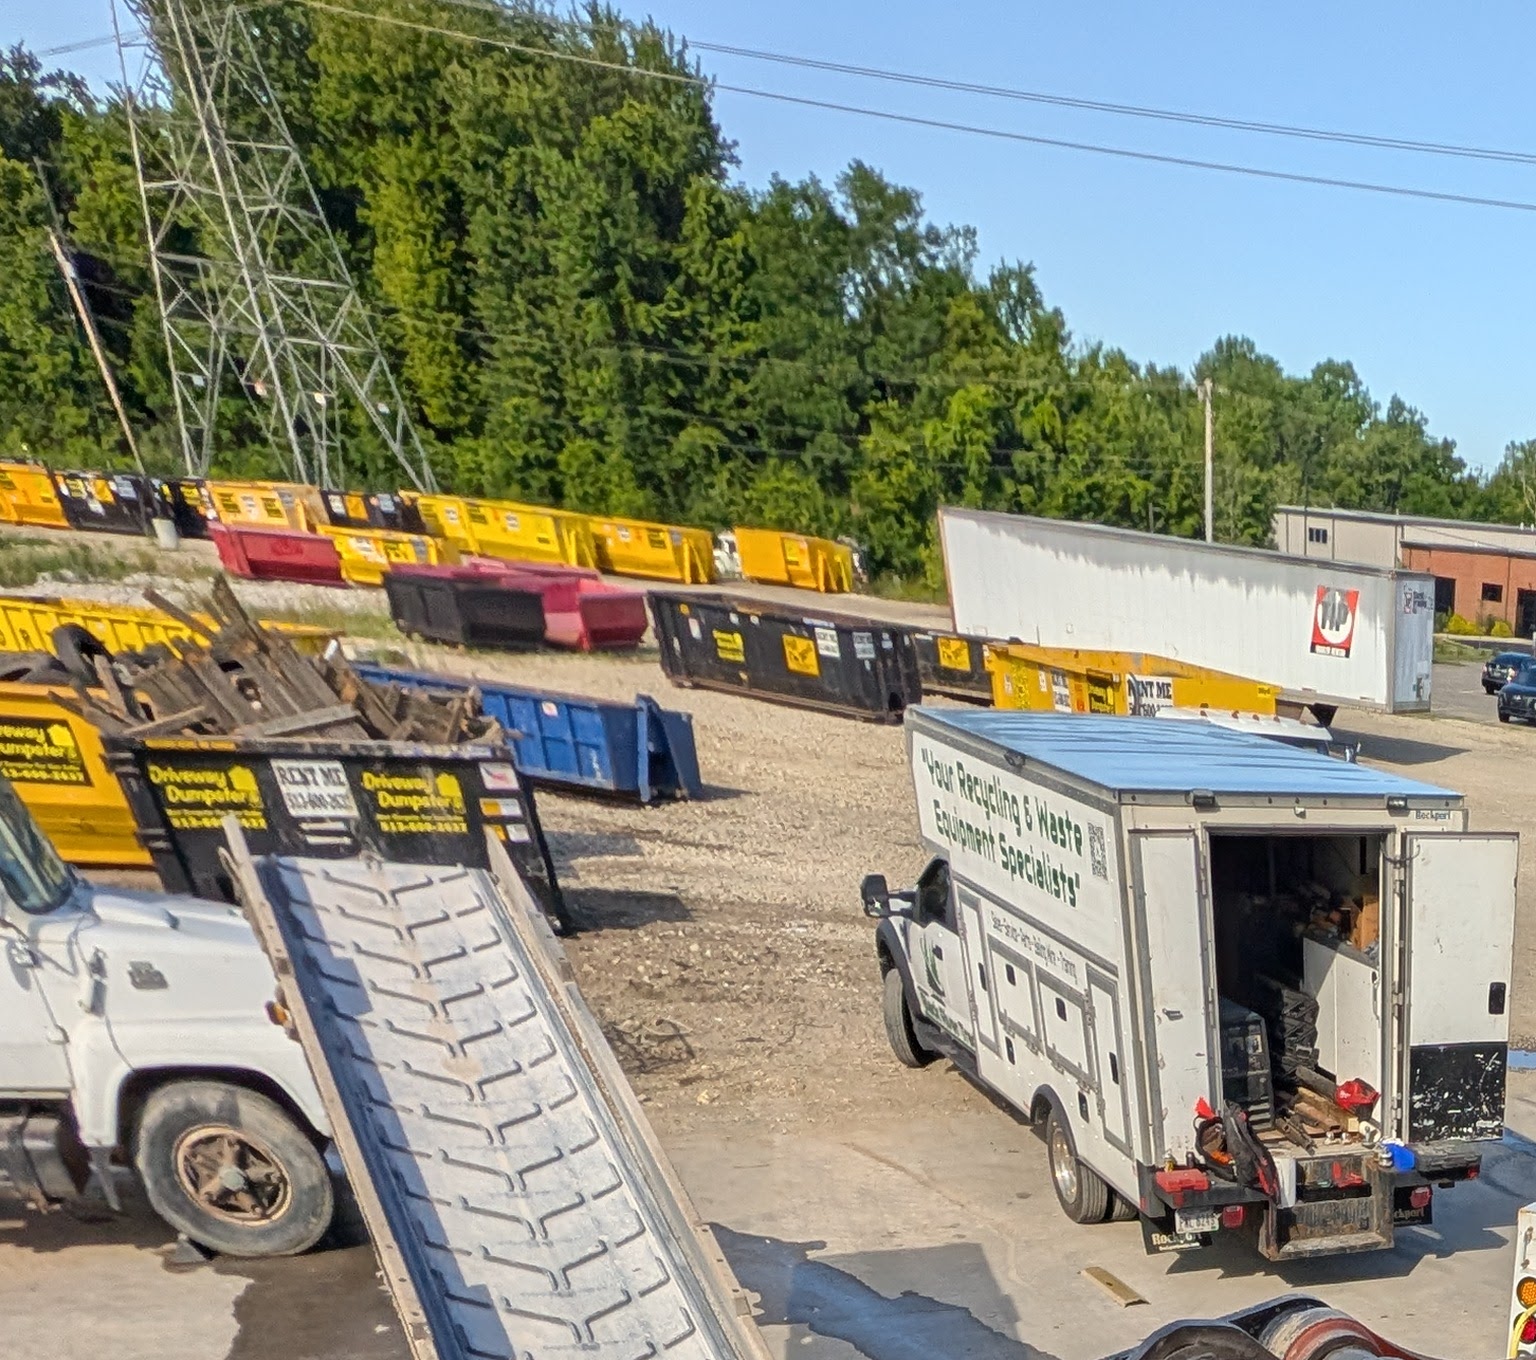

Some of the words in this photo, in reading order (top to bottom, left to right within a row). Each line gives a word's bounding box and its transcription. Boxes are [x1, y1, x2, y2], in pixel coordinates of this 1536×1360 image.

[1155, 681, 1172, 699] ME
[148, 764, 227, 789] Driveway
[362, 769, 434, 793] Driveway
[165, 784, 247, 807] Dumpster
[377, 791, 451, 811] Dumpster
[956, 760, 1022, 837] Recycling
[1023, 795, 1033, 832] &
[1034, 796, 1083, 857] Waste
[933, 799, 996, 863] Equipment
[999, 832, 1081, 907] Specialists"
[1394, 1208, 1424, 1220] ckport
